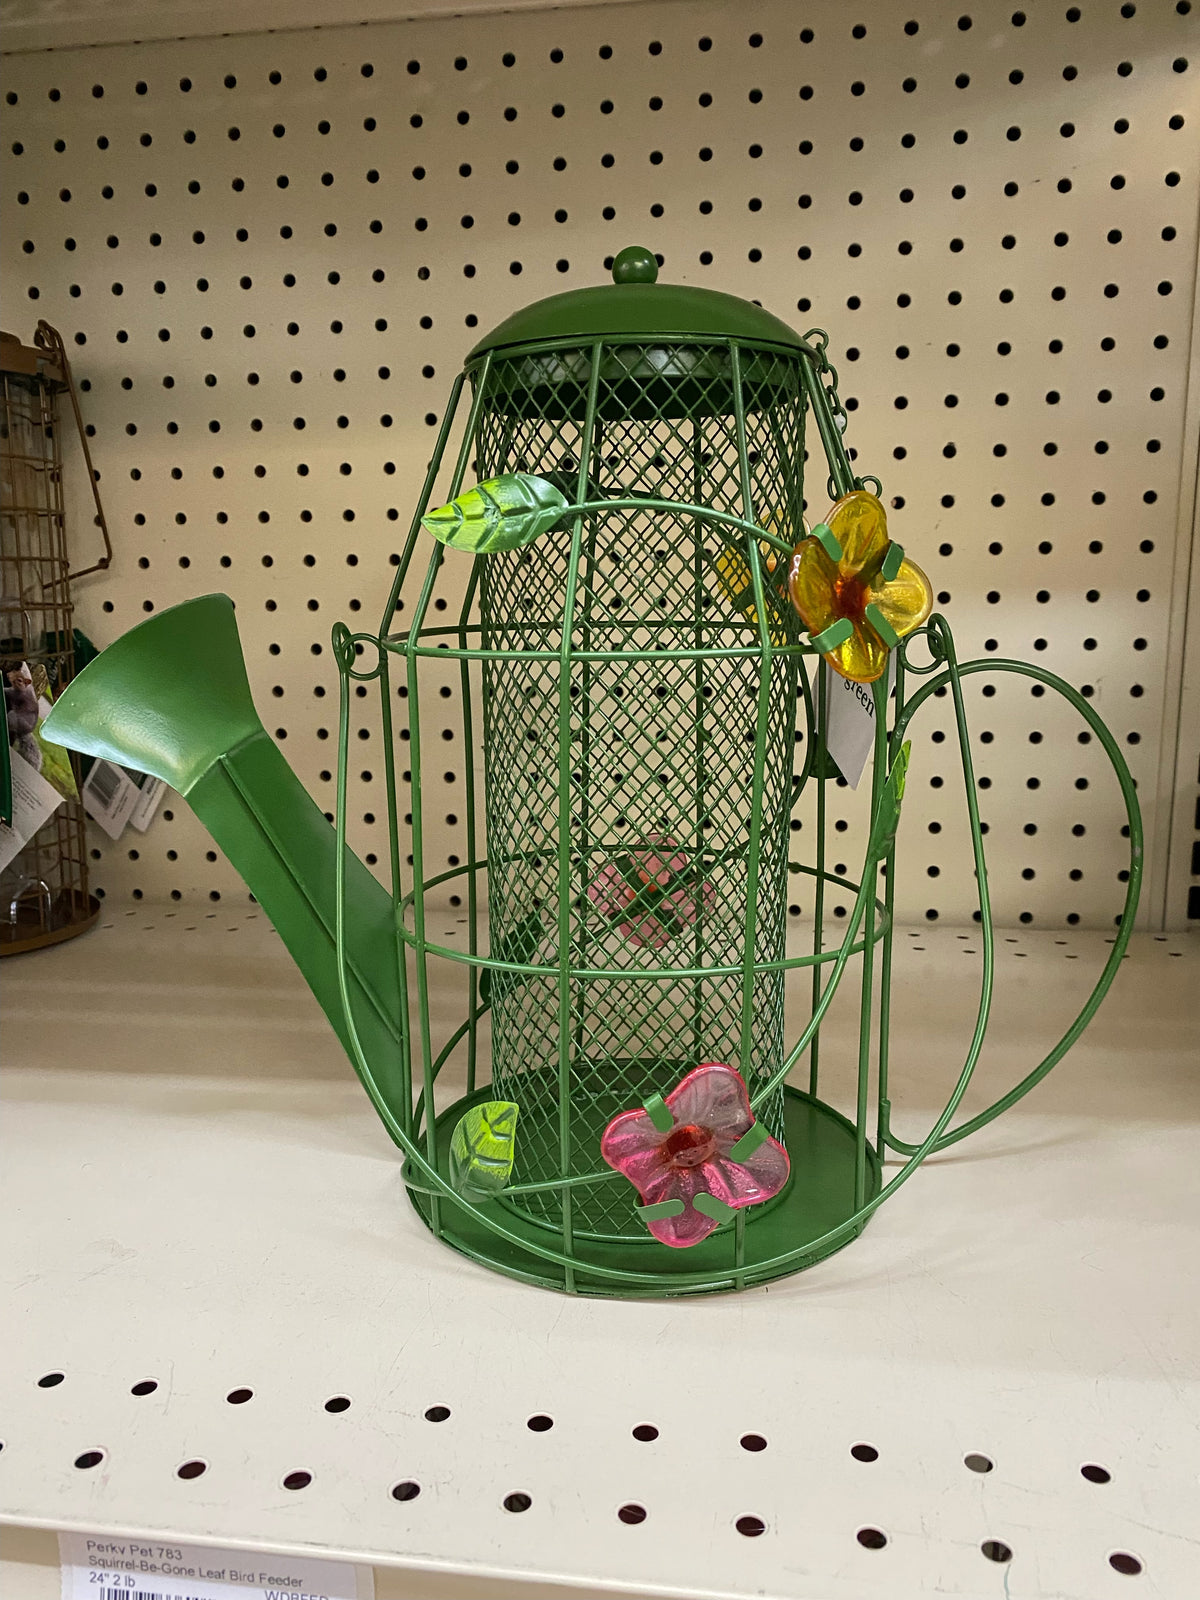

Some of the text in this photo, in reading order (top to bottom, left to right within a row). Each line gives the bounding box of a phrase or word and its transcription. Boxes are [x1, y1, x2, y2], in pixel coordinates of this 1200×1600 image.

[129, 1544, 153, 1558] Pet
[156, 1547, 183, 1560] 783
[88, 1555, 304, 1588] Squirrel-Be-Gone Leaf Bird Feeder
[89, 1571, 136, 1588] 24" 2 lb
